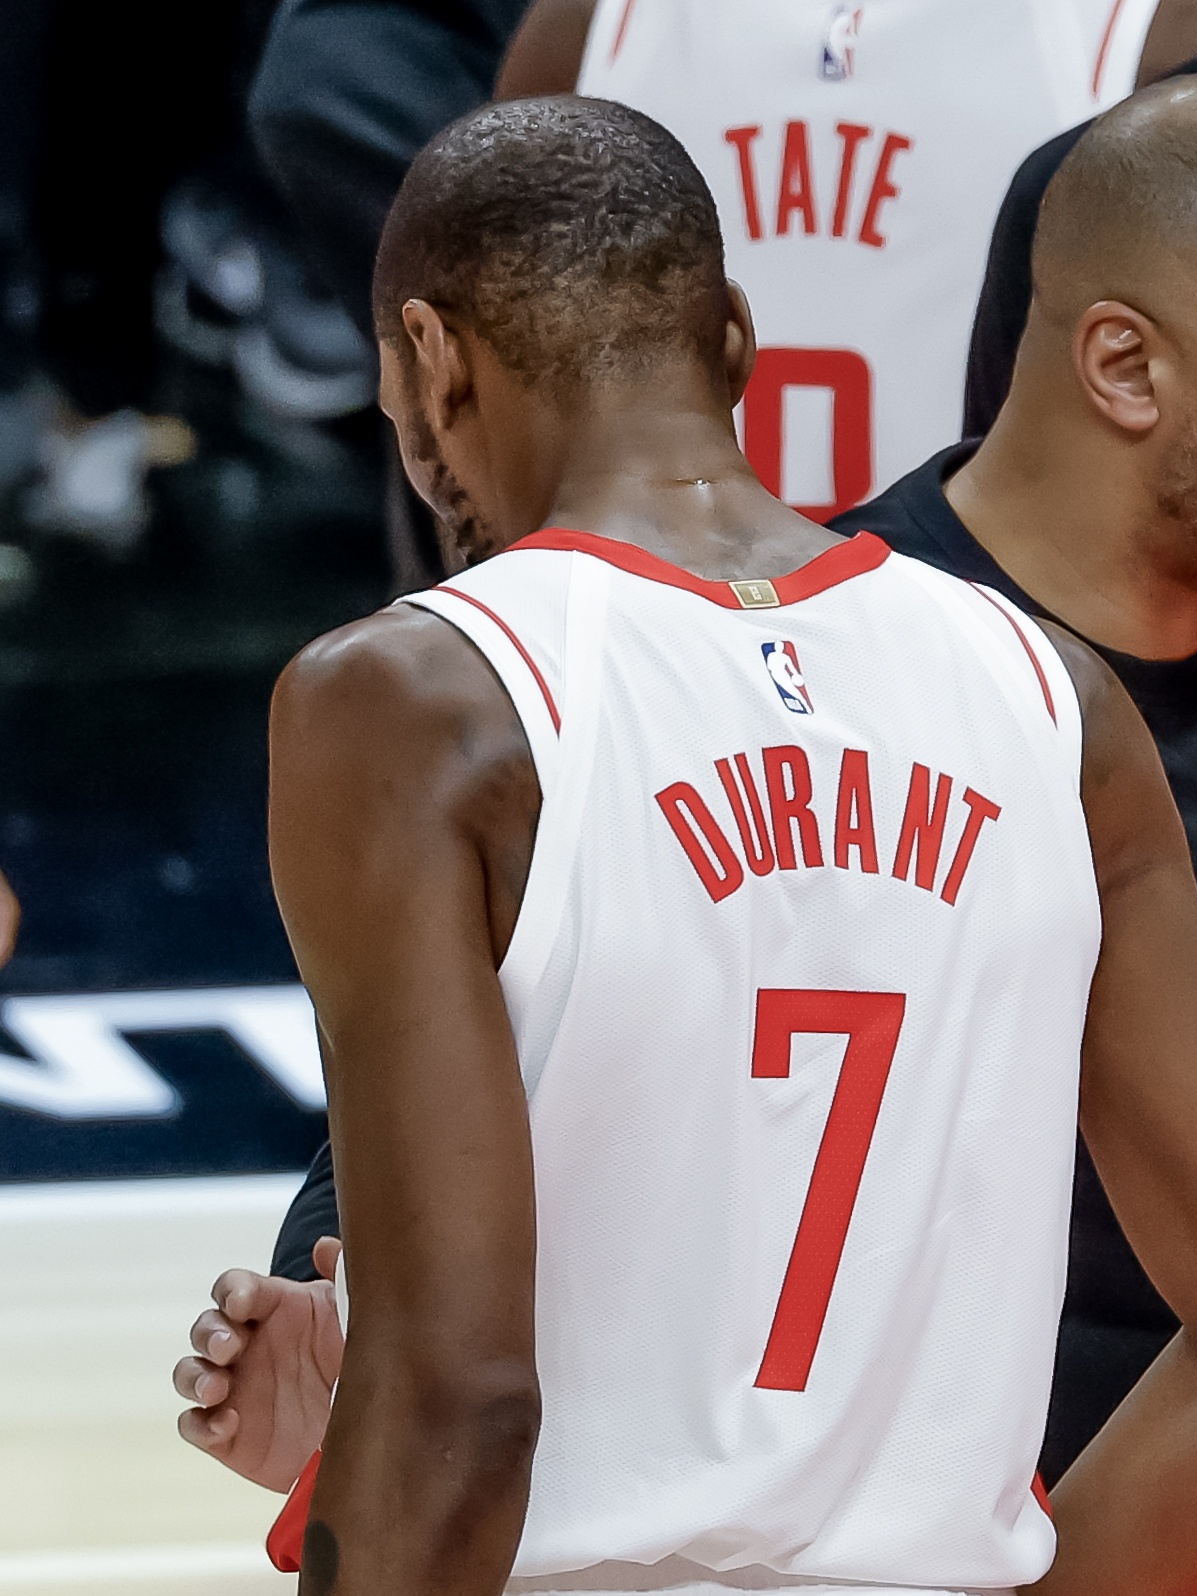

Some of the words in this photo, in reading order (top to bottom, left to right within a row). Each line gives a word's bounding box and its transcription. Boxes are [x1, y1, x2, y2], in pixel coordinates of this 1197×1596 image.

[724, 120, 911, 247] TATE
[741, 346, 874, 524] 0
[655, 744, 1002, 904] DURANT
[751, 989, 906, 1391] 7
